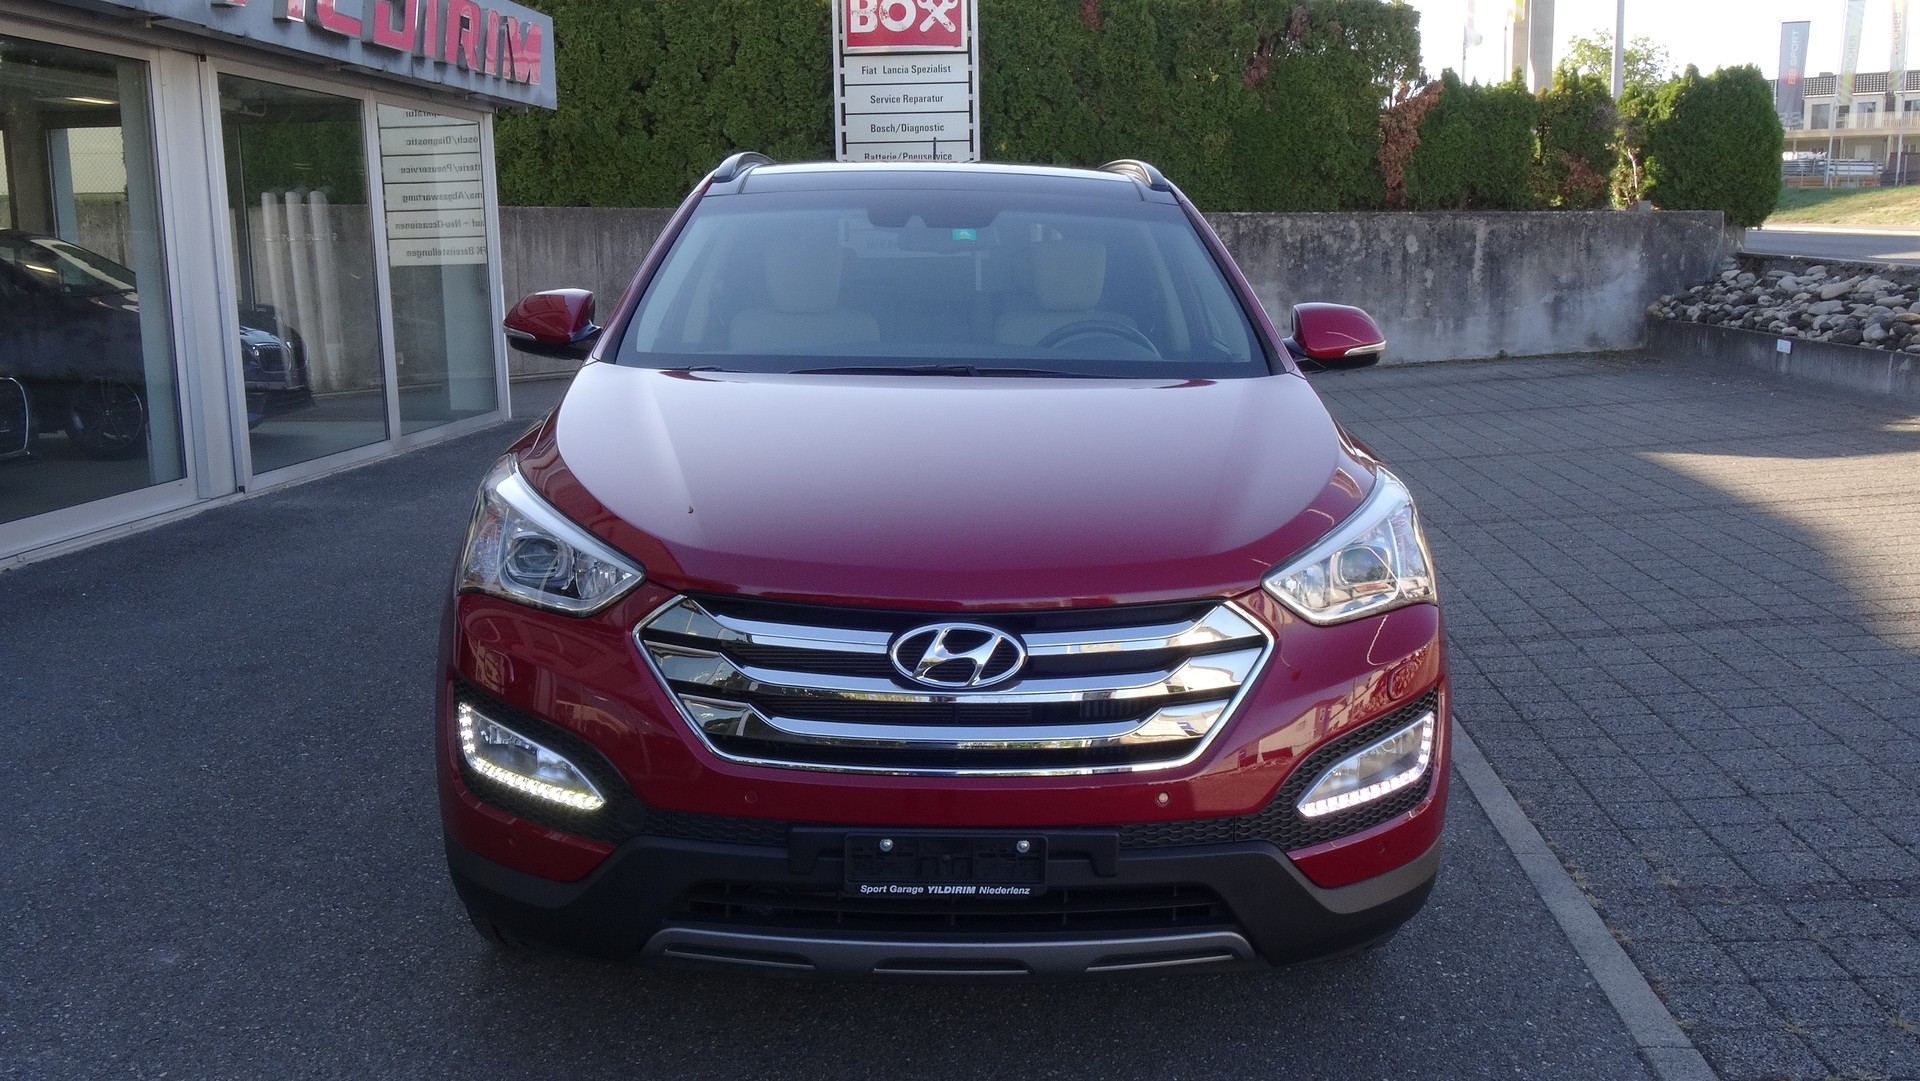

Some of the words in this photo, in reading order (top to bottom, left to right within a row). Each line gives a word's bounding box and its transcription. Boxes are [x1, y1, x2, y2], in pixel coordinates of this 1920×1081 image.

[1789, 29, 1800, 66] SPORT
[861, 65, 877, 75] Fiat
[882, 65, 909, 75] Lancia
[911, 64, 951, 75] Spezialist
[870, 94, 901, 104] Service
[902, 94, 944, 105] Reparatur
[870, 123, 945, 134] Bosch/Diagnostic
[864, 152, 952, 160] Batterie/Pneusevice
[860, 885, 887, 894] Sport
[889, 885, 924, 895] Garage
[927, 885, 977, 895] YILDIRIM
[978, 886, 1031, 895] Niederlenz
